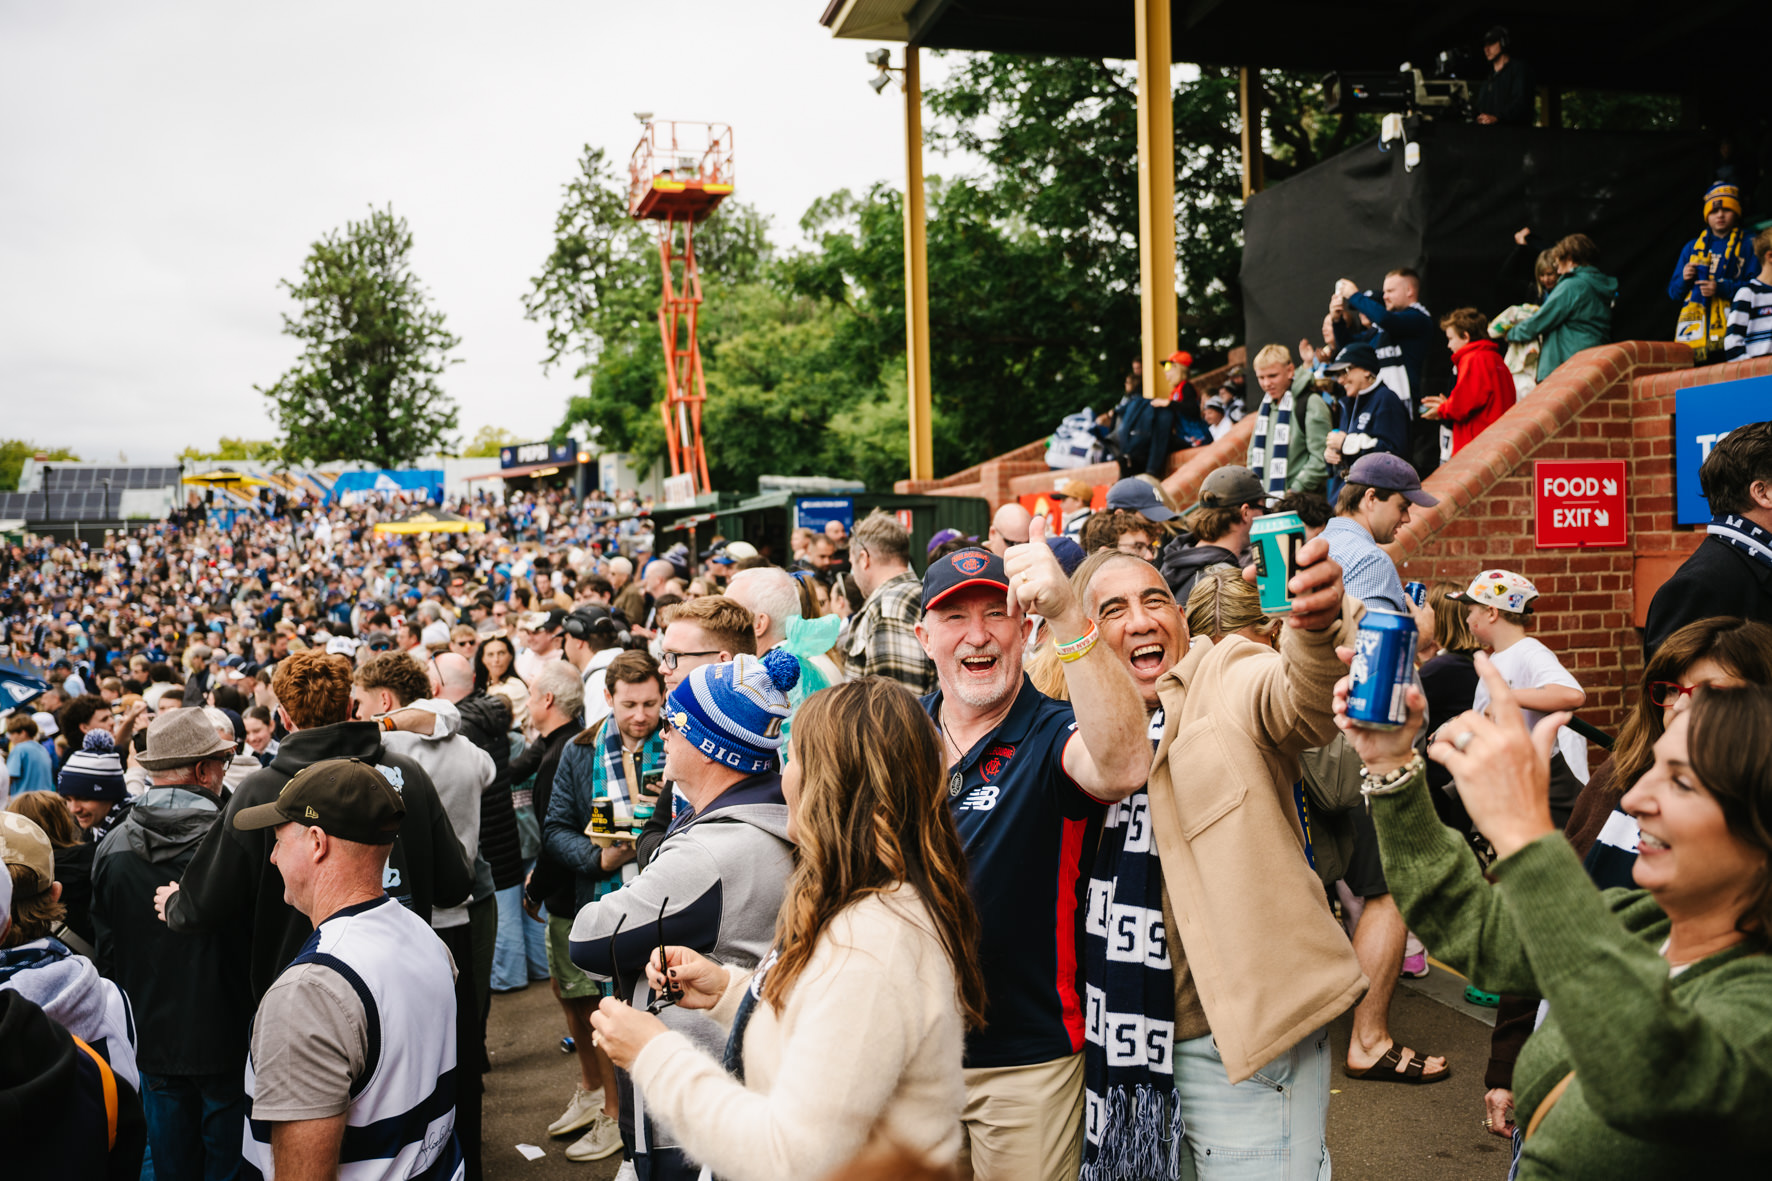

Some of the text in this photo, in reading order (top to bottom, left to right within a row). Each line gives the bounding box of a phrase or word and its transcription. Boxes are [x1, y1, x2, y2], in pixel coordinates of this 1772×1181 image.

[1543, 477, 1600, 498] FOOD
[1553, 508, 1592, 528] EXIT
[1076, 638, 1090, 649] SAN
[699, 737, 742, 767] BIG
